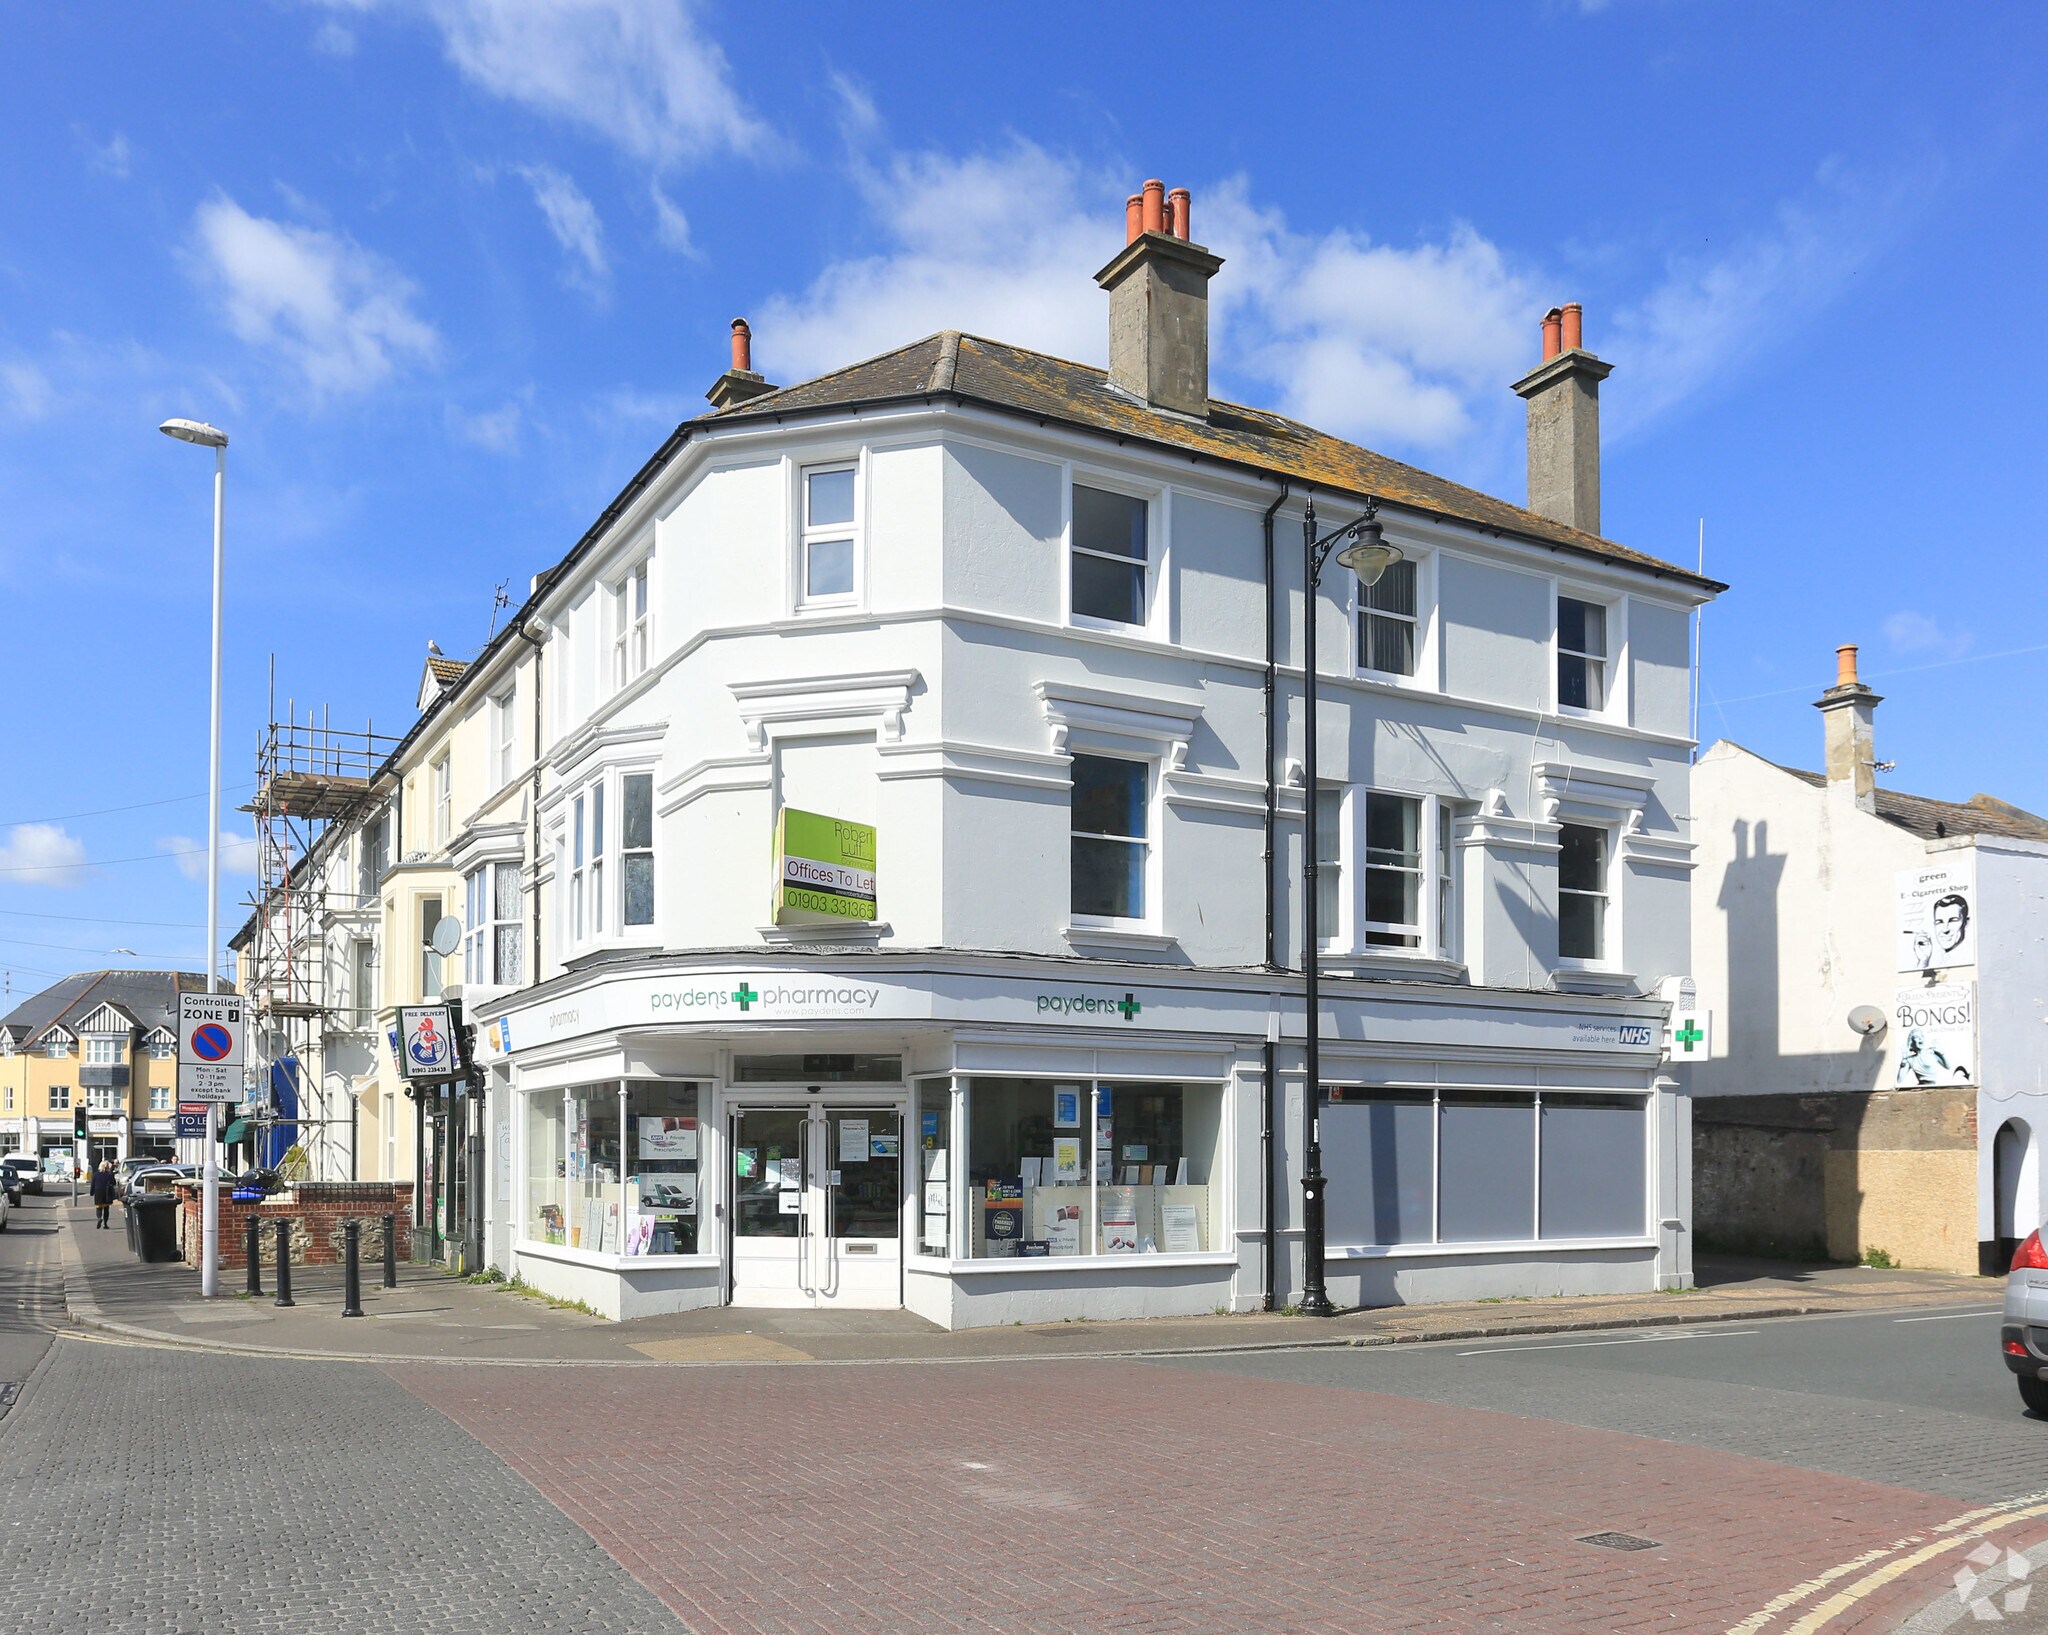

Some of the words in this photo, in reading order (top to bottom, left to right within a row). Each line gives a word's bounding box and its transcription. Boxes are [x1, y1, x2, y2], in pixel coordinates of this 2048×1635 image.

[787, 860, 834, 883] Offices
[837, 869, 853, 887] To
[856, 873, 874, 891] Let
[1918, 872, 1947, 884] green
[1911, 888, 1947, 897] Cigarette
[787, 890, 827, 912] 01903
[831, 898, 874, 920] 331365
[184, 996, 240, 1008] Controlled
[650, 988, 728, 1012] paydens
[763, 985, 880, 1008] pharmacy
[774, 1006, 865, 1016] www.paydens.com
[1037, 994, 1115, 1016] paydens
[183, 1009, 223, 1020] ZONE
[549, 1008, 580, 1031] pharmacy
[1896, 1001, 1971, 1028] BONGS!
[1579, 1023, 1592, 1031] NHS
[1572, 1034, 1601, 1042] available
[1601, 1035, 1616, 1043] here
[1620, 1027, 1651, 1044] NHS
[179, 1116, 195, 1125] TO
[197, 1116, 207, 1125] LE
